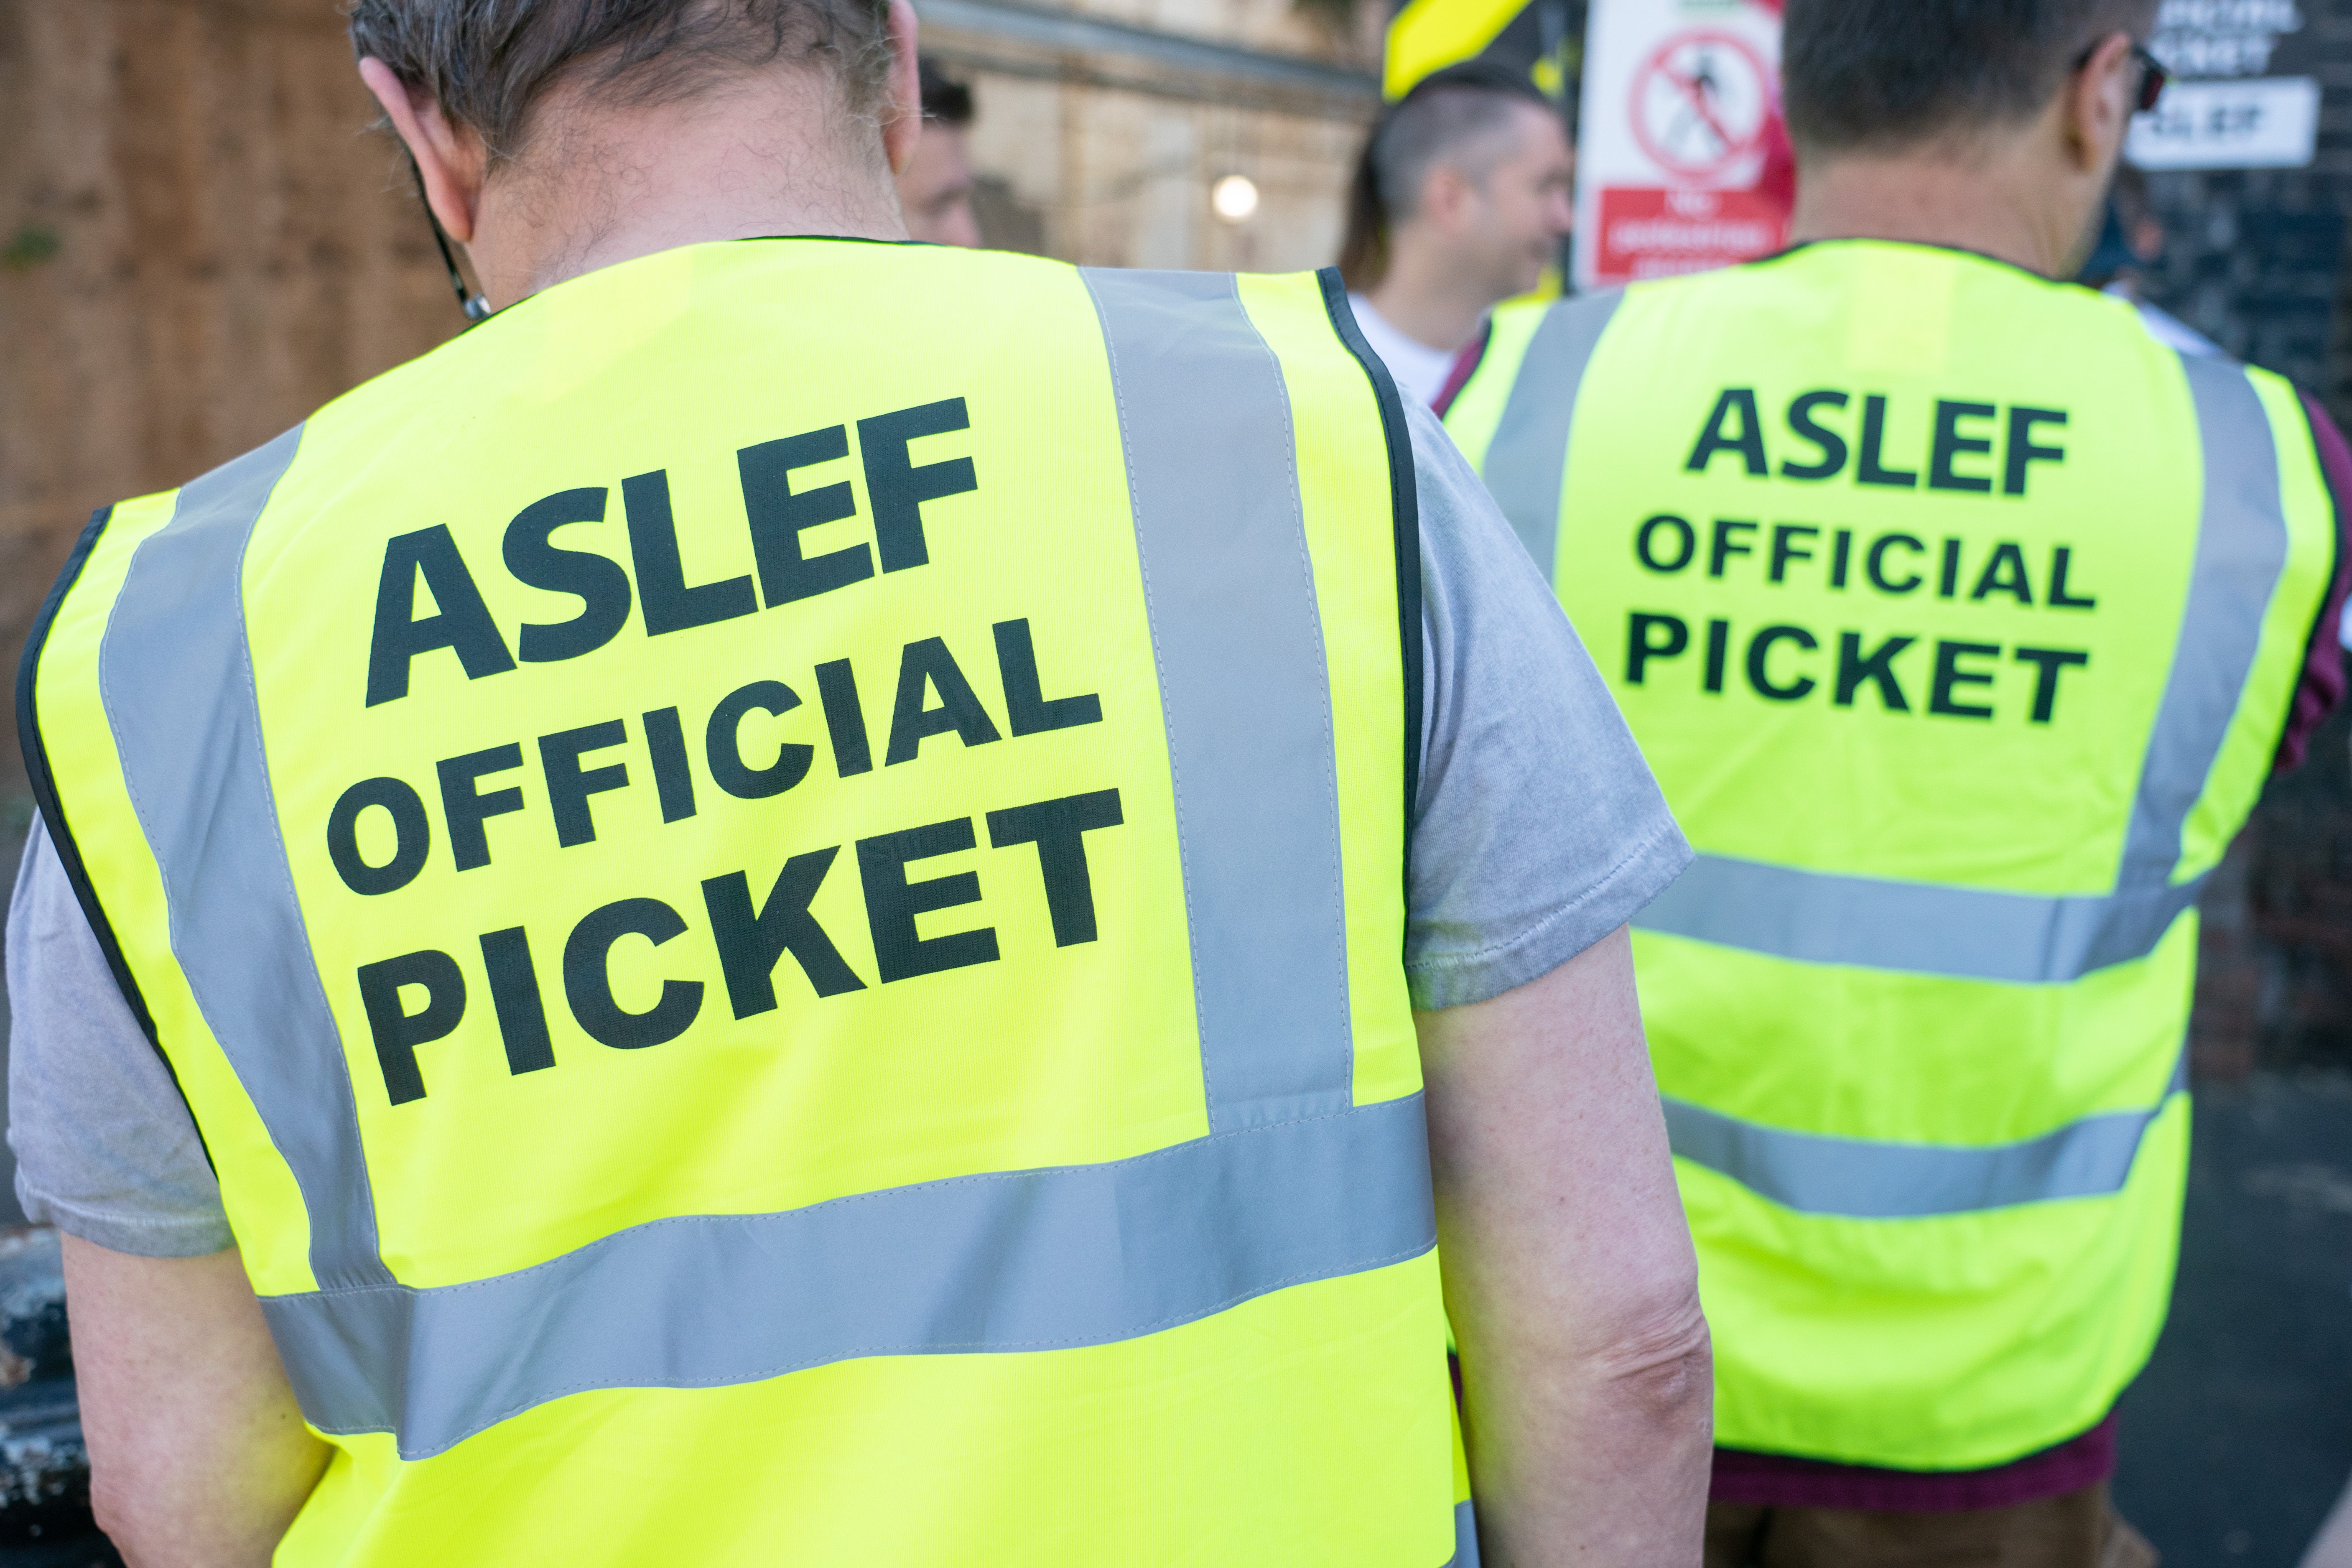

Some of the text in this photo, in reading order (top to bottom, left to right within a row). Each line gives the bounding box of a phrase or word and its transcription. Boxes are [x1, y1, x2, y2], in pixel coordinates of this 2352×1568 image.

[2148, 103, 2265, 138] SLEF
[1684, 388, 2067, 496] ASLEF
[366, 397, 977, 707] ASLEF
[1634, 513, 2097, 609] OFFICIAL
[1624, 611, 2089, 723] PICKET
[328, 618, 1102, 895] OFFICIAL
[358, 788, 1123, 1105] PICKET
